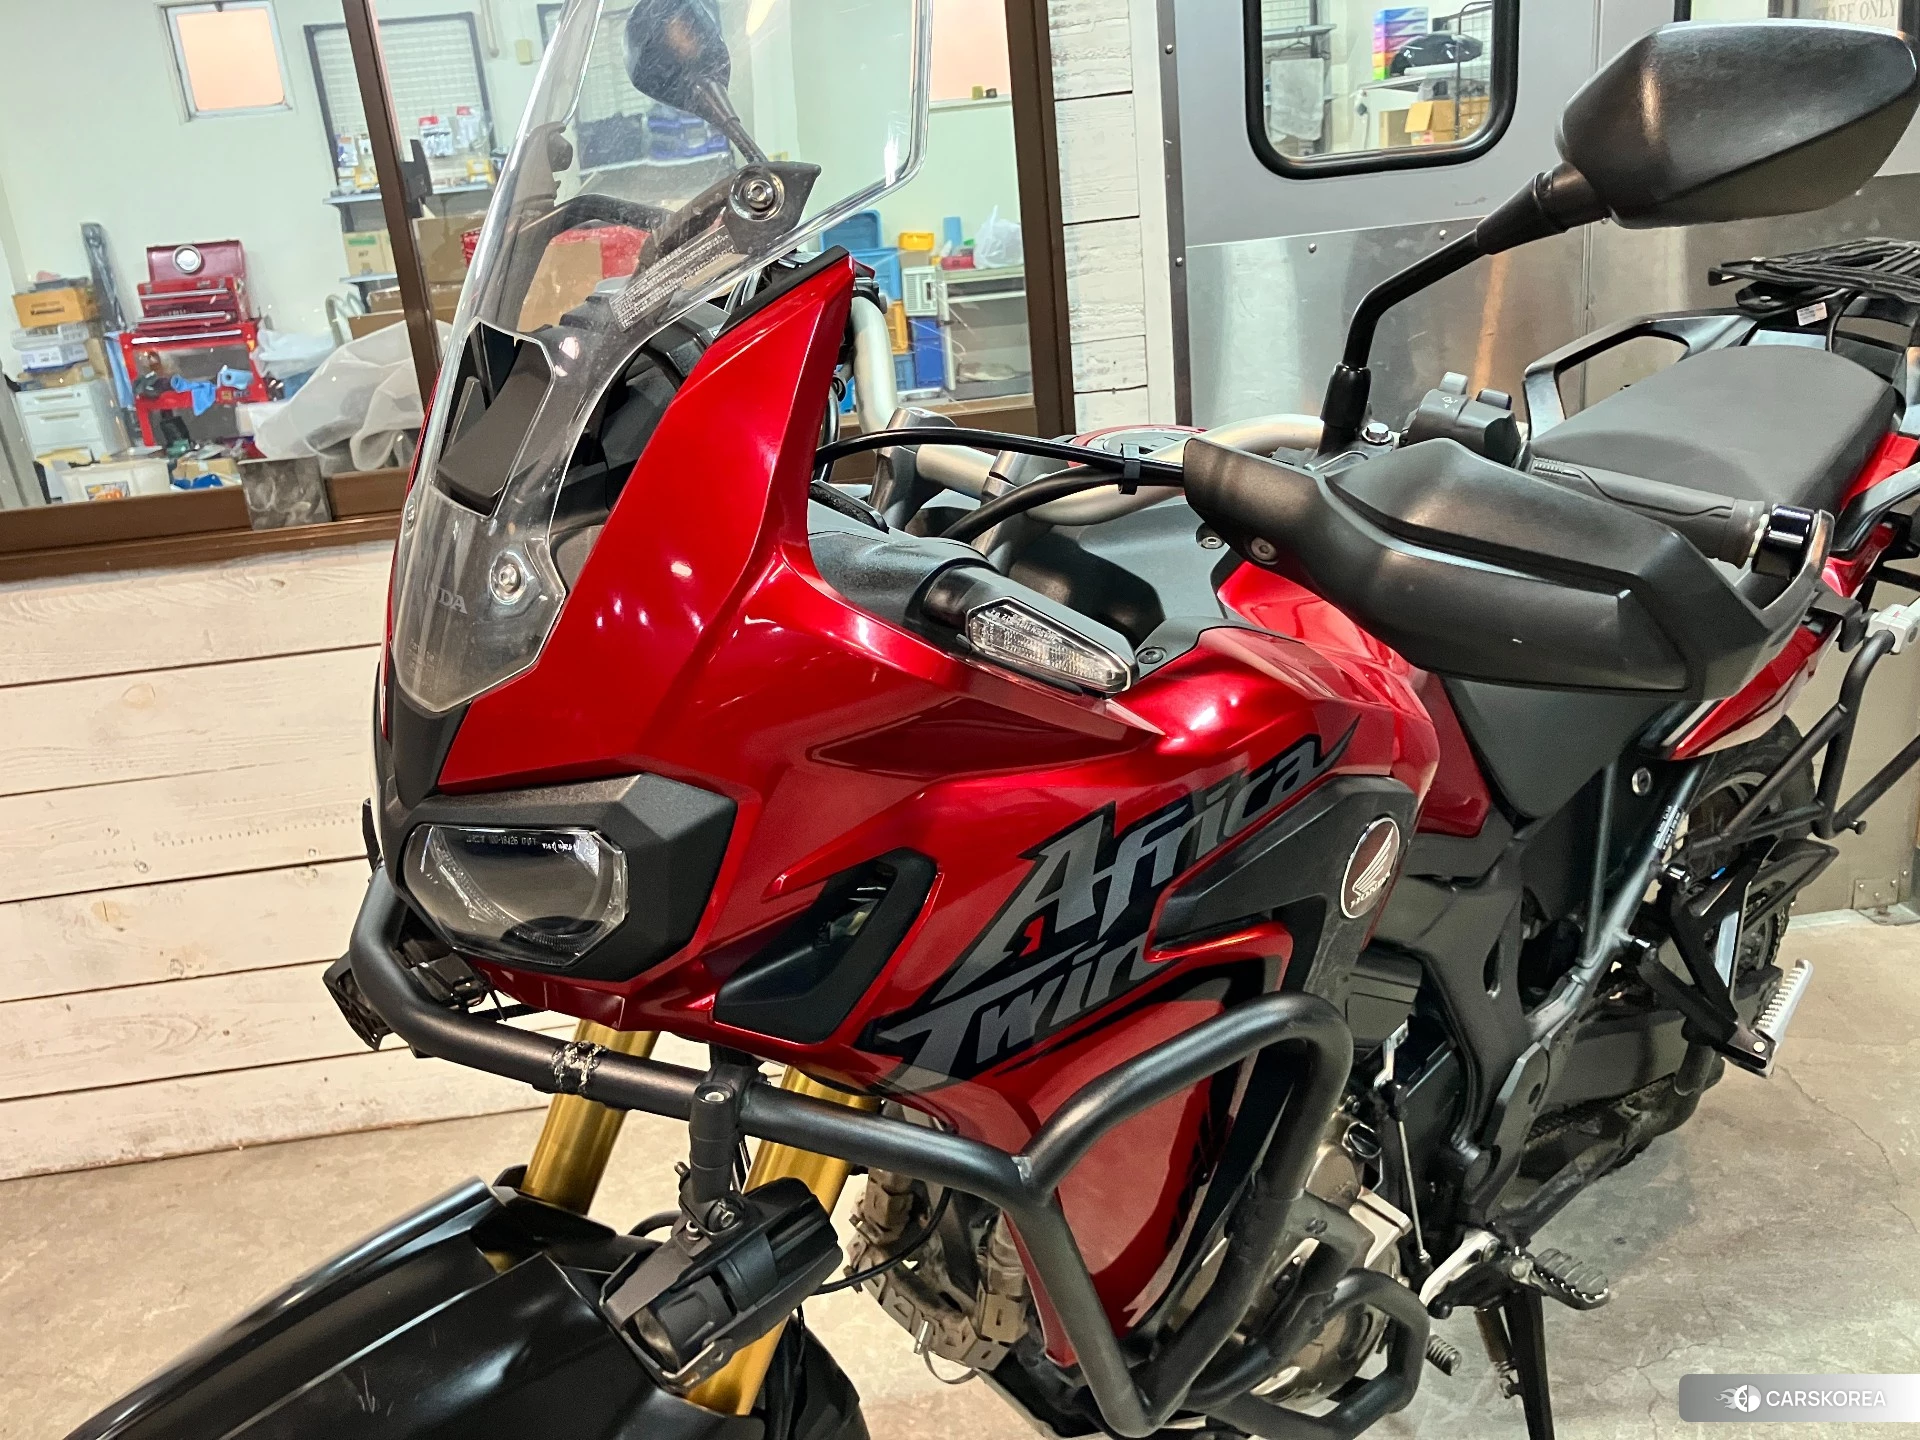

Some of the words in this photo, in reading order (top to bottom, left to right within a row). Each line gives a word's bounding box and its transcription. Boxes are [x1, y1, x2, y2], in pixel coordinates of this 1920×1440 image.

[1859, 0, 1896, 20] ONLY
[930, 720, 1358, 1004] Africa
[1350, 870, 1391, 909] HONDA
[878, 930, 1162, 1085] Twin
